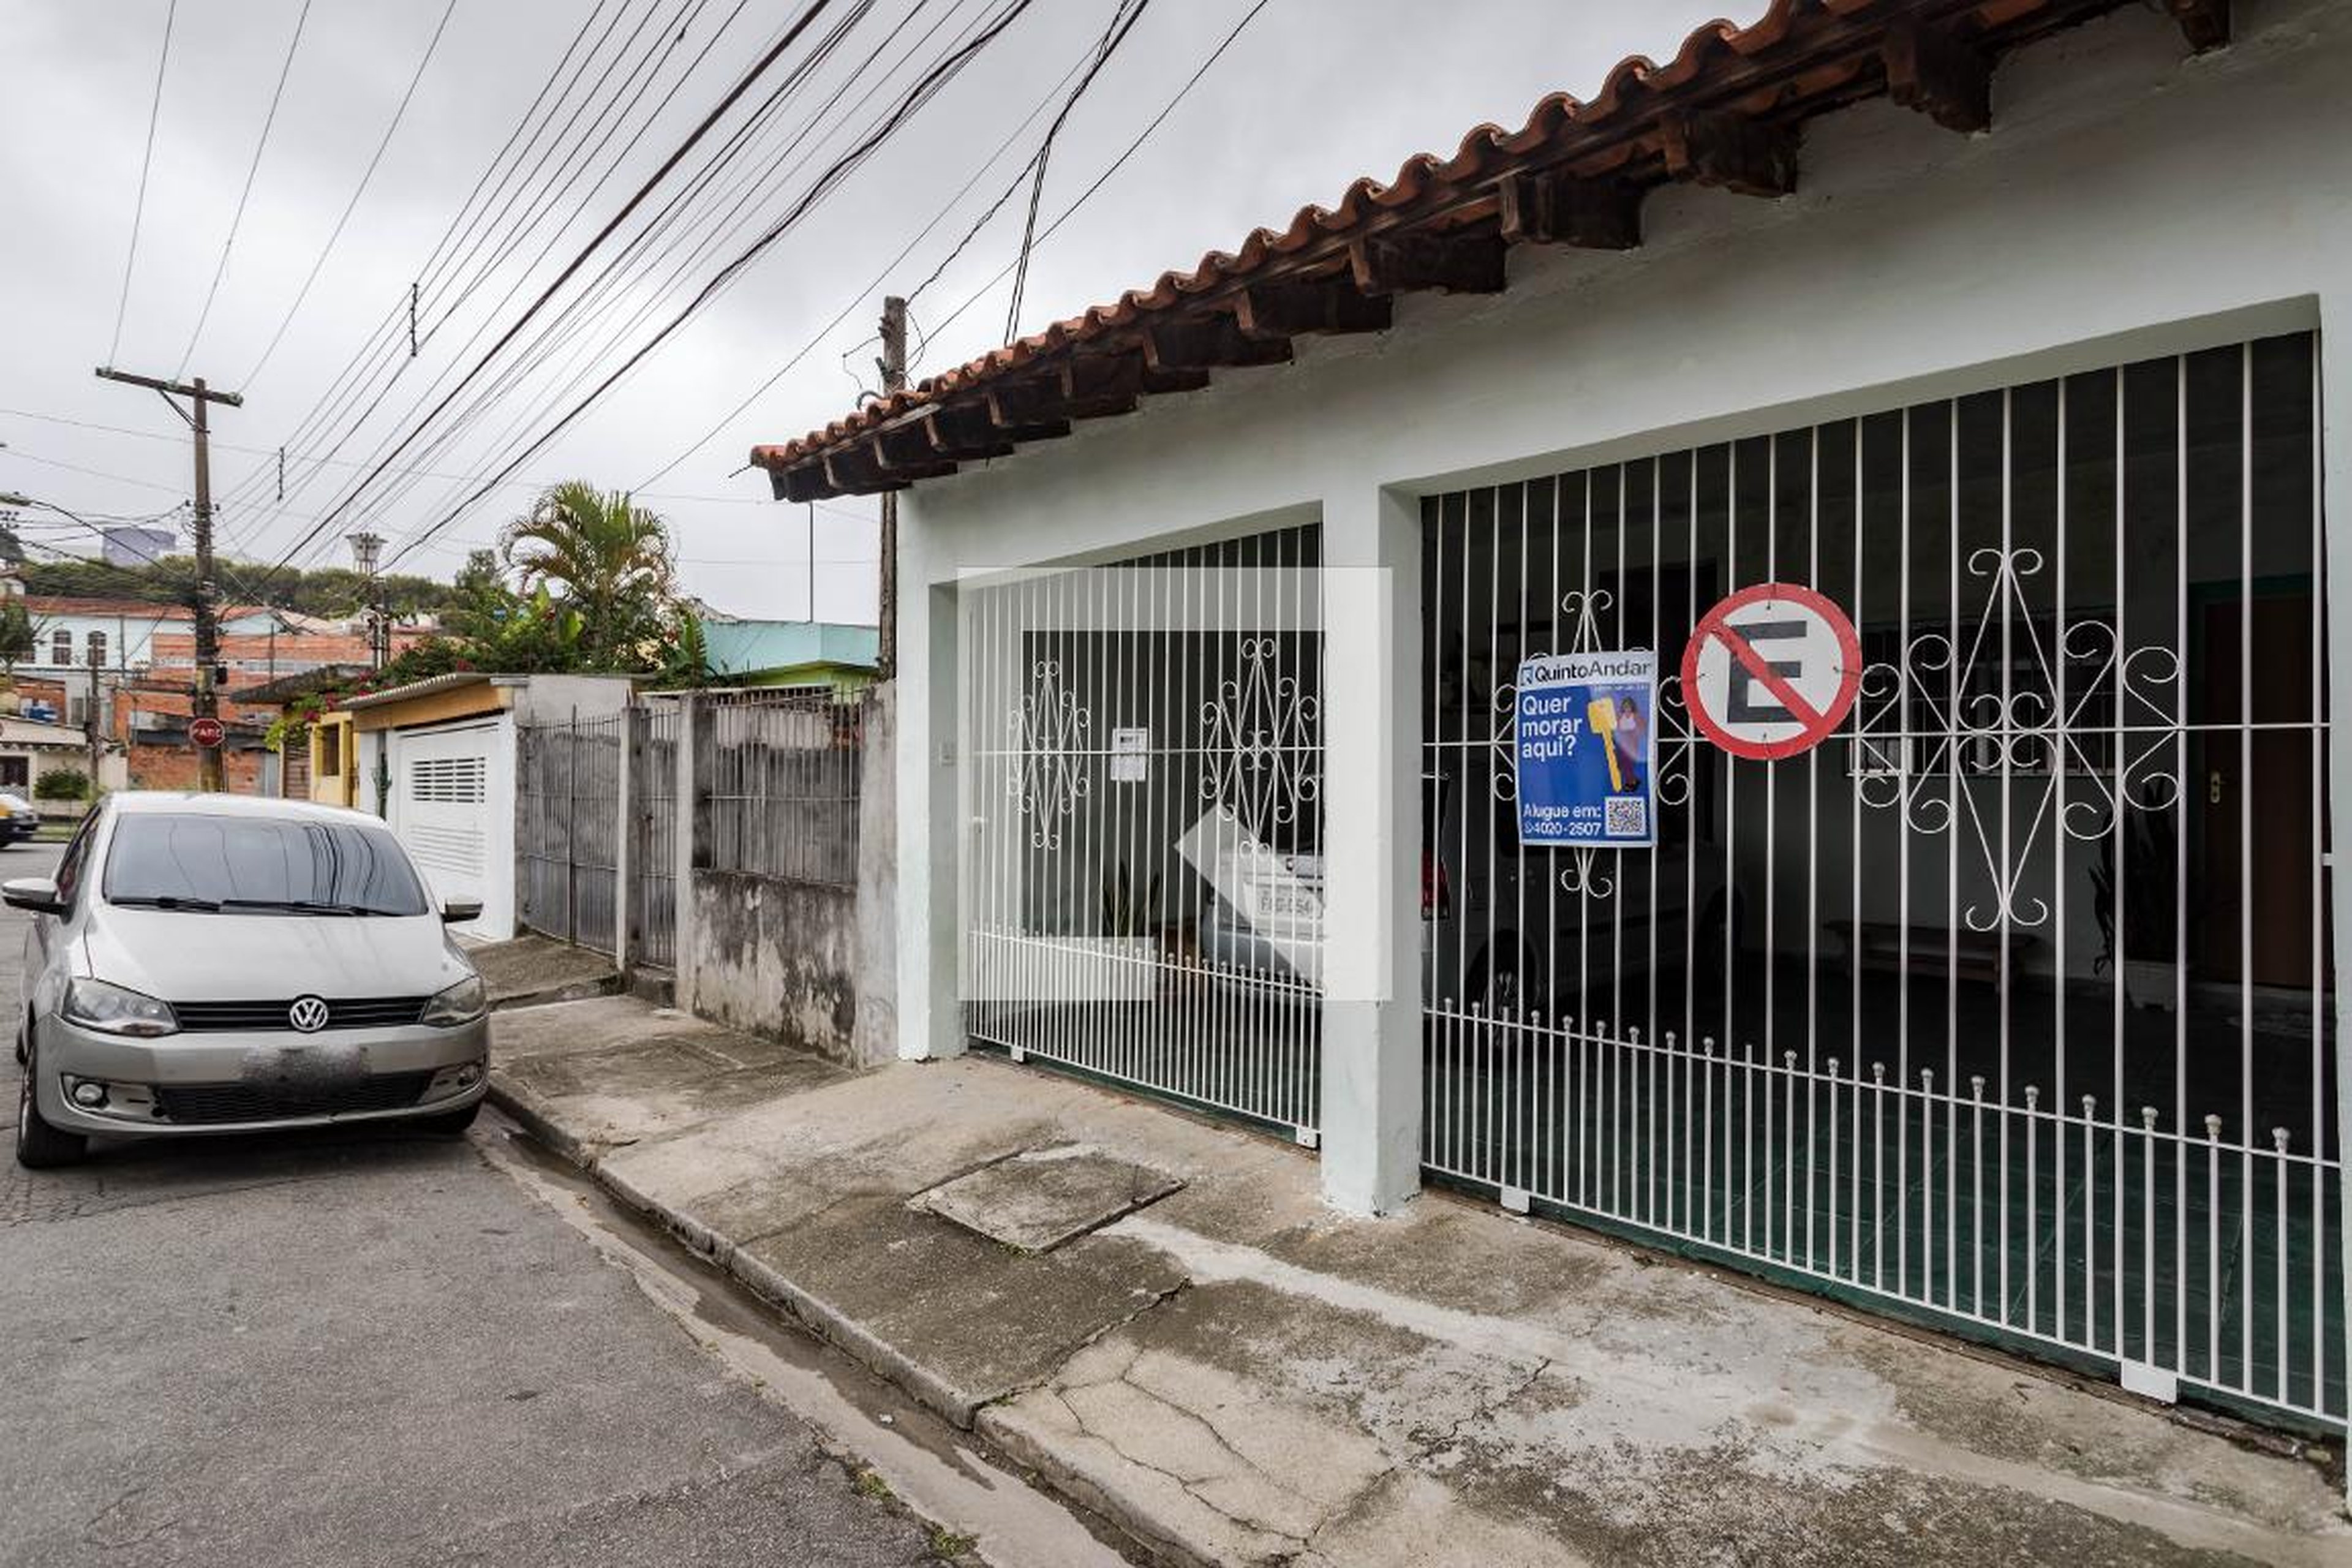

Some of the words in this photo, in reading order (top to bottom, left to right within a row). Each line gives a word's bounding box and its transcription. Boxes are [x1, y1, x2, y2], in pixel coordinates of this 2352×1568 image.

[1534, 660, 1651, 683] QuintoAndar
[1727, 620, 1807, 723] E
[1522, 695, 1572, 715] Quer
[1522, 718, 1583, 737] morar
[1522, 735, 1577, 762] aqui?
[1523, 802, 1570, 821] Alugue
[1572, 804, 1602, 818] em:
